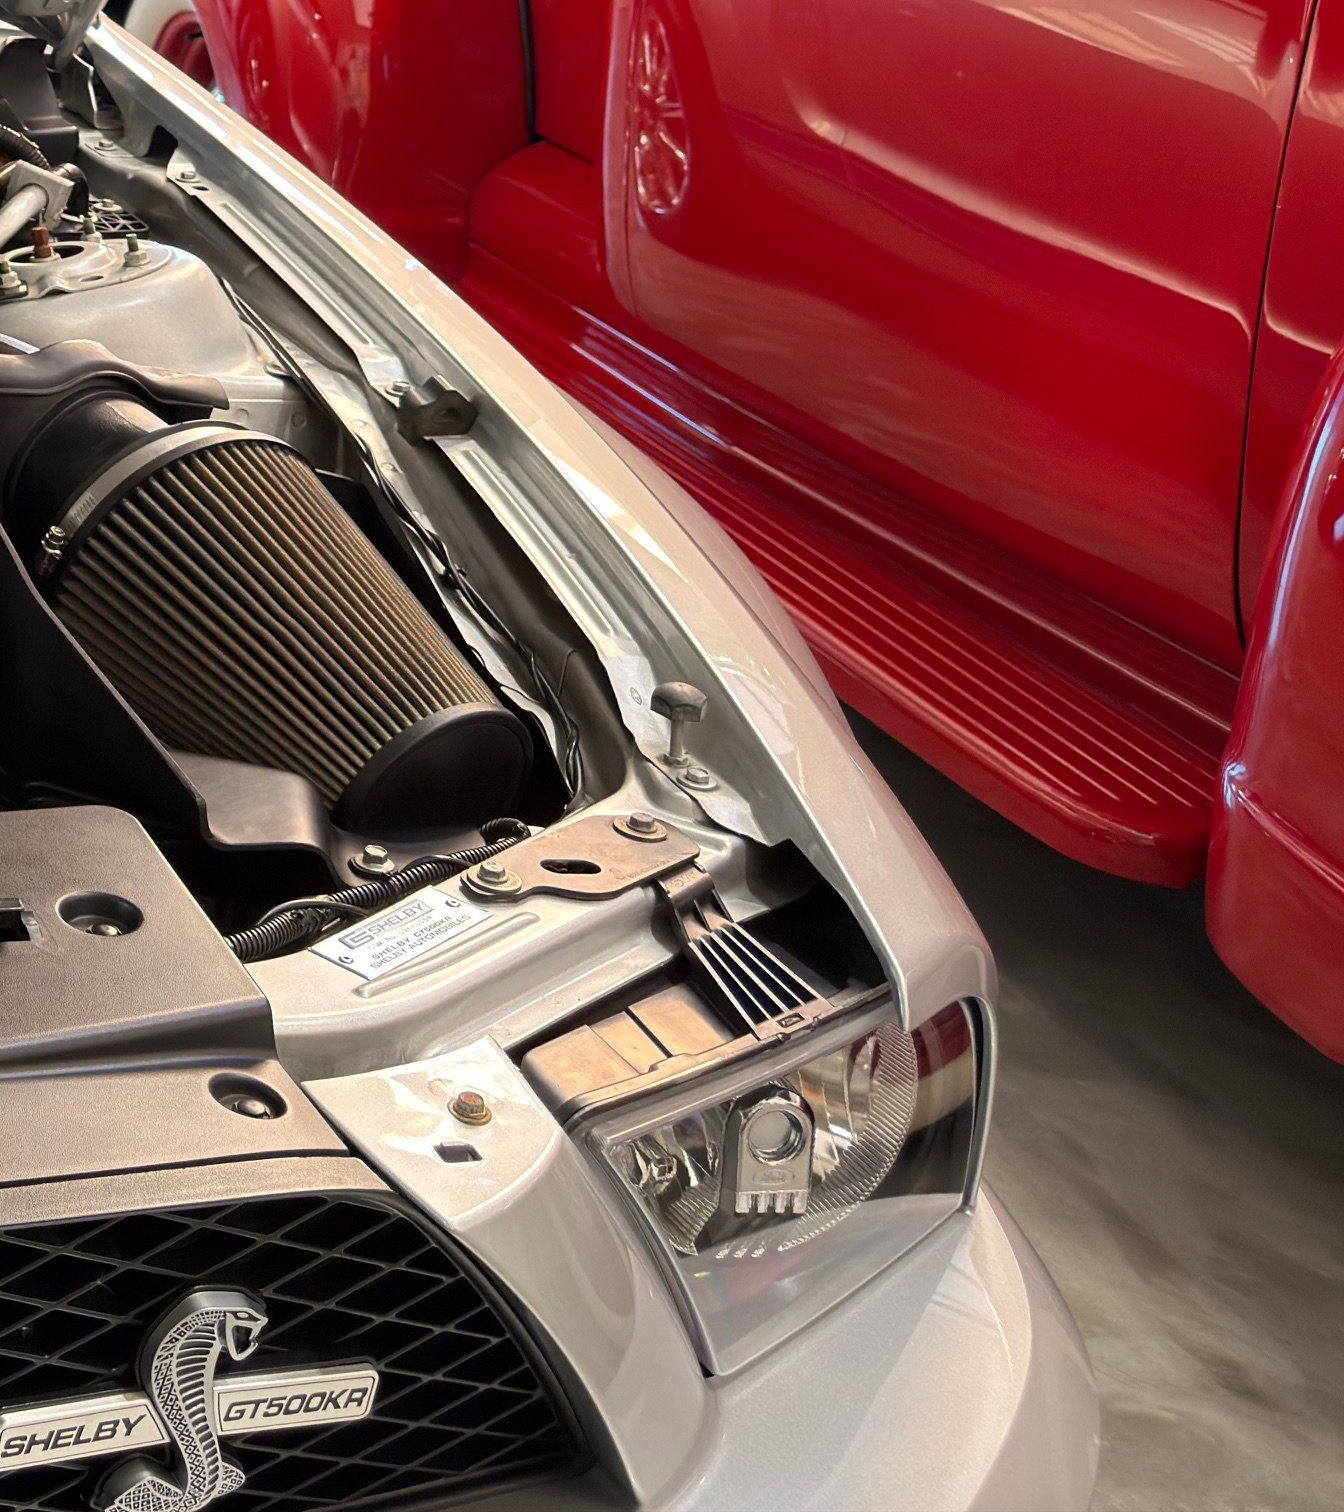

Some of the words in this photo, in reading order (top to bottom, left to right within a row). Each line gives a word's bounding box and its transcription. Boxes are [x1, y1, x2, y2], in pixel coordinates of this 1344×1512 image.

[367, 902, 425, 935] SHELBY
[370, 947, 408, 969] SHELBY
[408, 914, 472, 949] AUTOMOBILES
[371, 936, 410, 960] SHELBY
[0, 1413, 149, 1459] SHELBY
[223, 1386, 370, 1423] GT500KR
